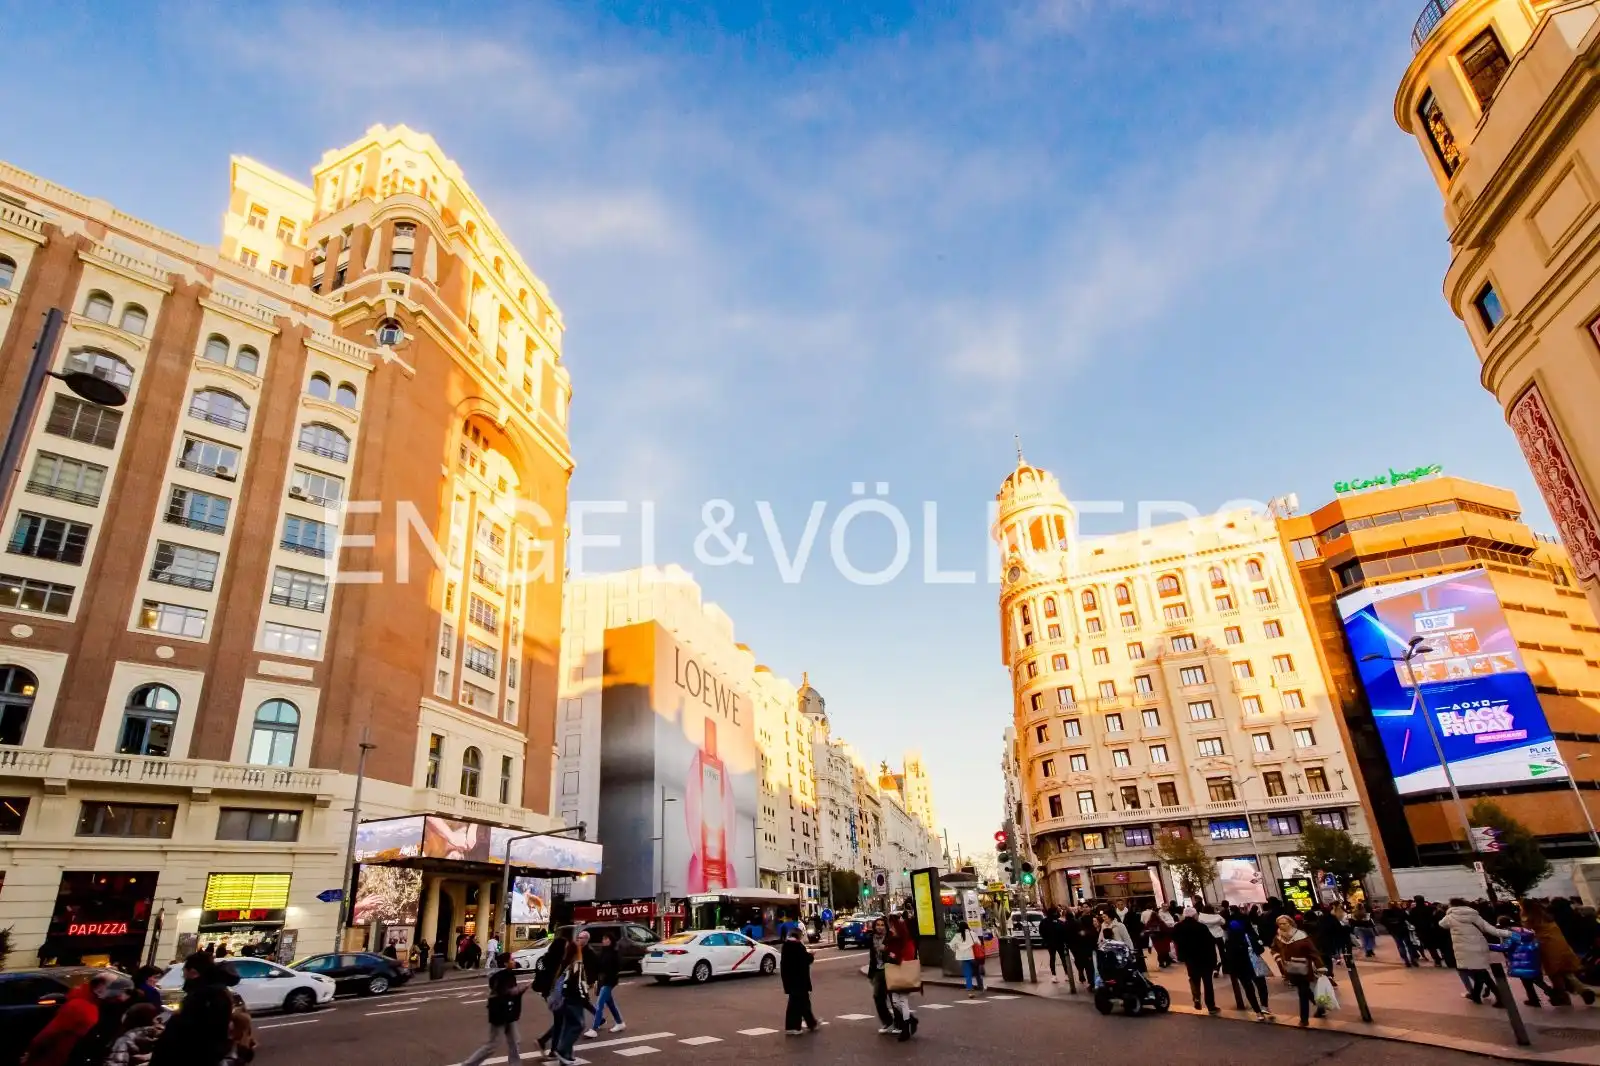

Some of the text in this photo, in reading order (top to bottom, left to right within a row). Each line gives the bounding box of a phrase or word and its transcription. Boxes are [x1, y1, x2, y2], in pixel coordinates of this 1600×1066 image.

[675, 646, 741, 727] LOEWE
[1436, 705, 1513, 724] BLACK
[1441, 716, 1513, 737] FRIDAY
[1529, 746, 1552, 754] PLAY
[596, 907, 618, 917] FIVE
[622, 905, 649, 915] GUYS
[68, 922, 128, 936] PAPIZZA
